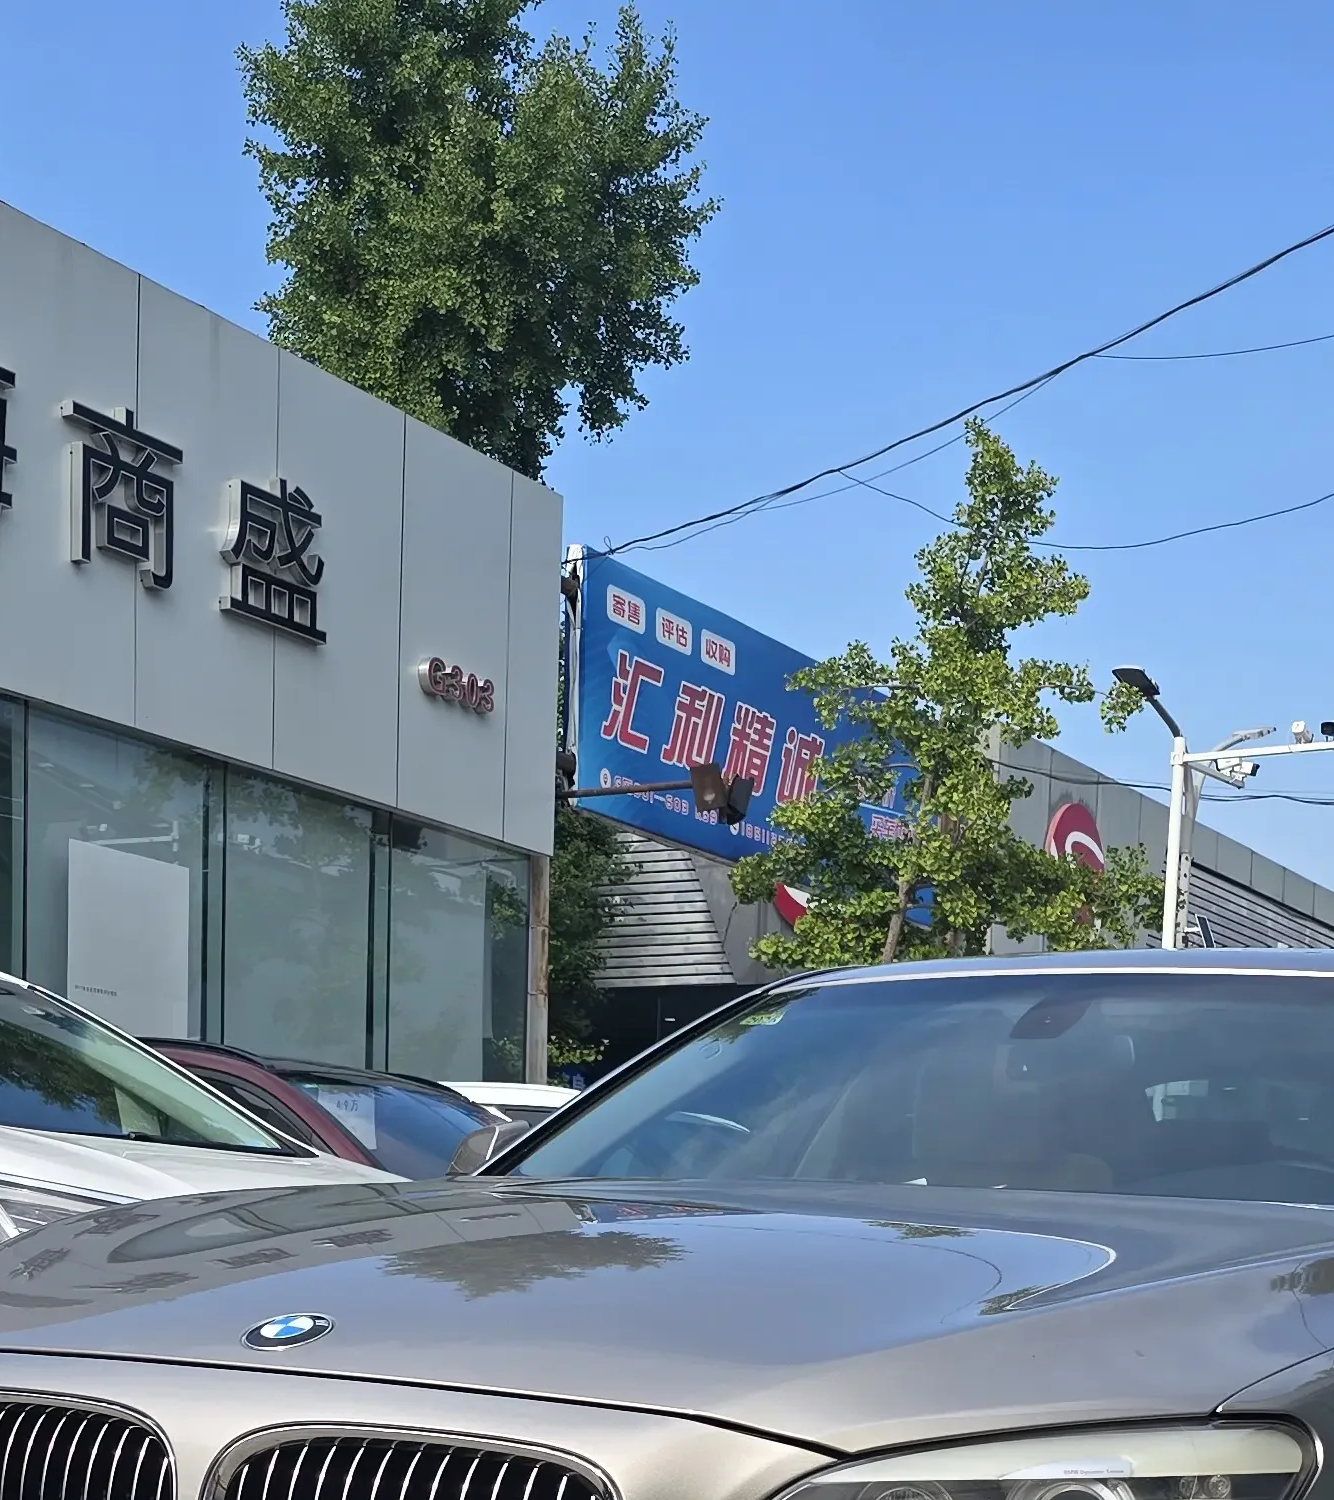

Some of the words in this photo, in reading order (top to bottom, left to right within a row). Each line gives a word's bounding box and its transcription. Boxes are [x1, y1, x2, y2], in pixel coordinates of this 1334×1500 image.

[612, 593, 641, 626] 寄售
[661, 616, 688, 648] 评估
[705, 638, 731, 668] 收购
[418, 656, 495, 713] G303
[601, 649, 825, 806] 汇利精诚
